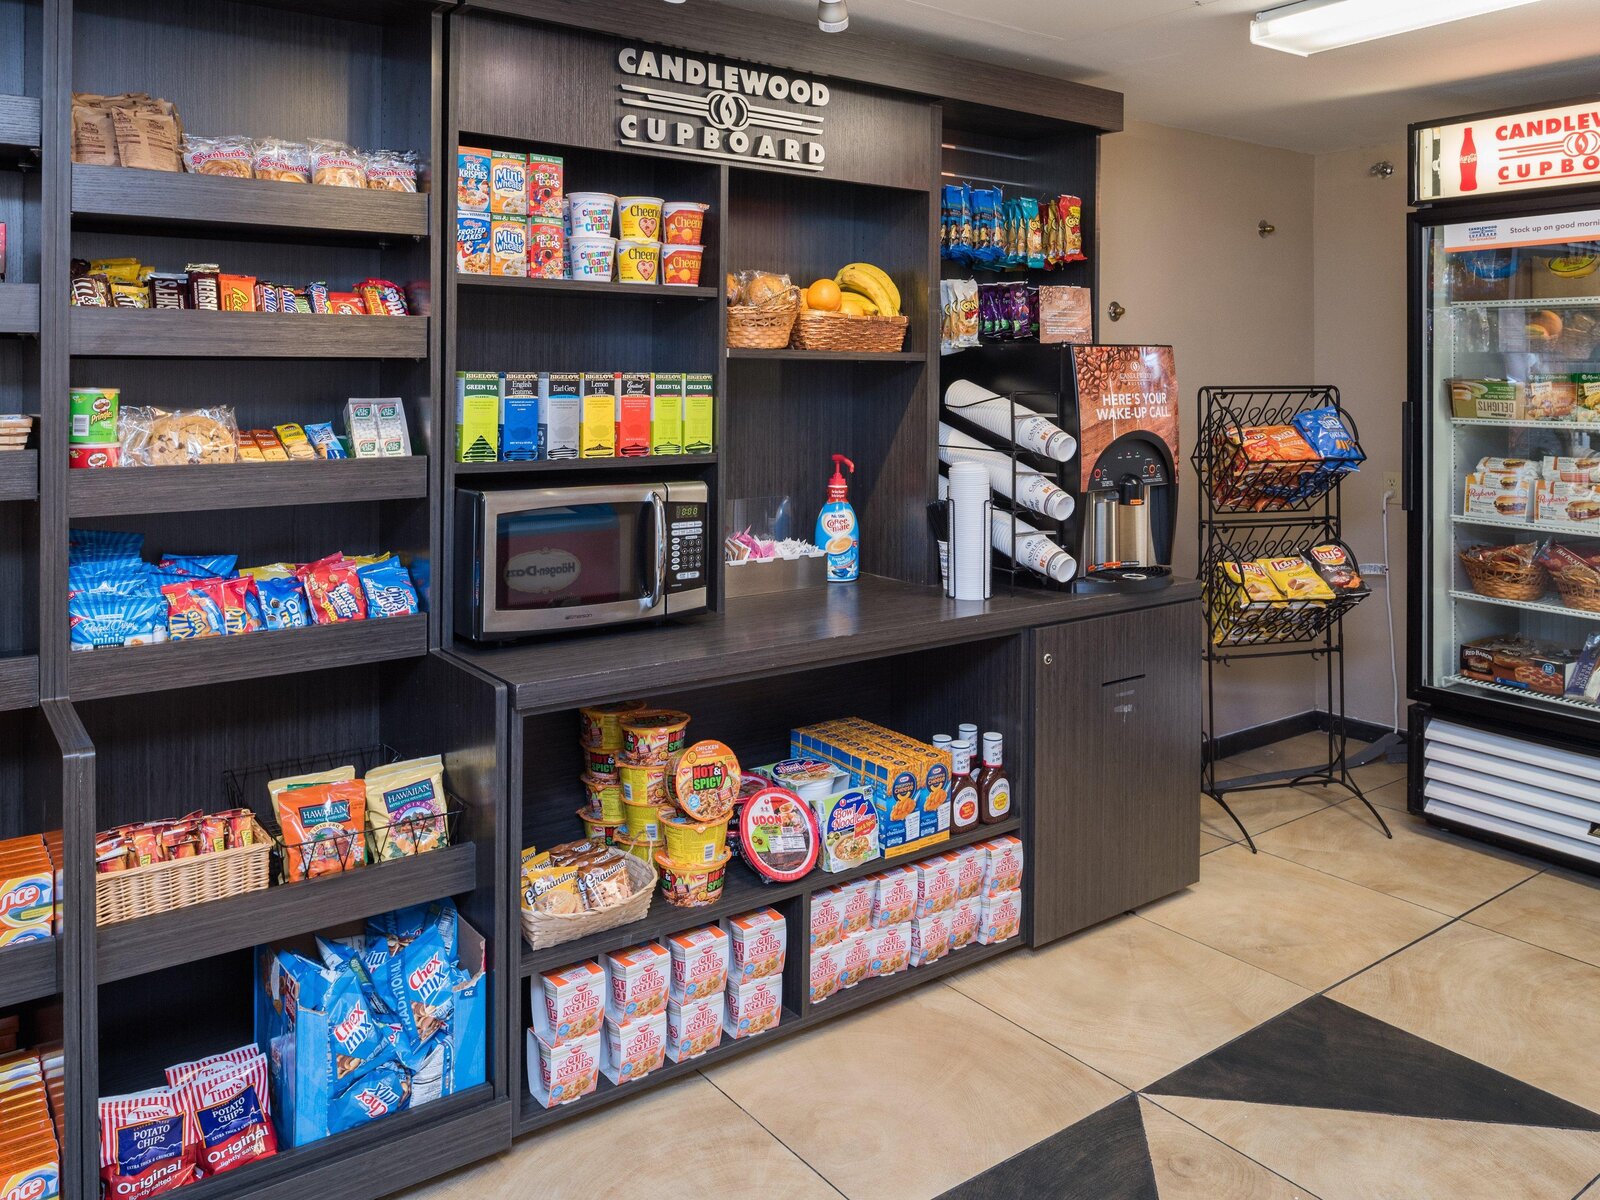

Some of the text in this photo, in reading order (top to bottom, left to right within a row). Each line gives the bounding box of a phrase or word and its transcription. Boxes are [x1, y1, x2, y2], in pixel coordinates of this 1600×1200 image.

[618, 48, 830, 107] CANDLEWOOD
[620, 114, 826, 164] CUPBOARD
[192, 149, 247, 165] Svenhard's
[459, 170, 488, 179] KRISPIES
[466, 163, 481, 172] RICE
[457, 227, 486, 236] FROSTED
[1510, 226, 1530, 234] Stock
[1555, 221, 1575, 233] good
[458, 233, 482, 241] FLAKES
[512, 380, 532, 388] English
[1102, 392, 1167, 406] HERE'S YOUR
[1096, 406, 1147, 421] WAKE-UP
[1477, 401, 1515, 413] DELIGHTS
[91, 411, 113, 425] Pringles
[826, 518, 848, 529] Coffee
[1314, 547, 1342, 562] Lay's
[330, 591, 353, 619] Butter
[334, 584, 359, 614] Nutter
[93, 633, 125, 644] minis
[1476, 650, 1494, 662] BARON
[592, 753, 607, 763] HOT
[591, 763, 615, 773] SPICY
[693, 764, 722, 777] HOT &
[693, 775, 721, 791] SPICY
[387, 783, 432, 804] HAWAIIAN
[396, 801, 430, 819] ORIGINAL
[833, 804, 857, 820] Bowl
[752, 815, 783, 827] UDON
[832, 813, 862, 830] Noodle
[964, 862, 978, 873] CUP
[1001, 855, 1015, 867] CUP
[935, 874, 951, 886] CUP
[891, 886, 908, 897] CUP
[852, 893, 868, 906] CUP
[818, 906, 835, 917] CUP
[957, 909, 971, 922] CUP
[999, 902, 1012, 915] CUP
[930, 922, 944, 935] CUP
[755, 934, 775, 950] CUP
[883, 935, 900, 947] CUP
[748, 939, 781, 959] NOODLES
[852, 945, 867, 958] CUP
[698, 952, 718, 968] CUP
[817, 960, 832, 971] CUP
[409, 952, 441, 992] Chex
[690, 958, 724, 978] NOODLES
[639, 971, 659, 986] CUP
[631, 976, 665, 997] NOODLES
[390, 958, 414, 1032] TRADITIONAL
[571, 989, 592, 1004] CUP
[751, 989, 770, 1004] CUP
[562, 995, 599, 1018] NOODLES
[743, 994, 776, 1014] NOODLES
[333, 1002, 368, 1044] Chex
[693, 1010, 712, 1025] CUP
[685, 1015, 718, 1036] NOODLES
[634, 1030, 654, 1046] CUP
[625, 1036, 661, 1058] NOODLES
[565, 1051, 587, 1067] CUP
[556, 1057, 594, 1080] NOODLES
[207, 1082, 243, 1104] Tim's
[212, 1096, 246, 1119] POTATO
[354, 1090, 389, 1119] Chex
[132, 1108, 170, 1120] Tim's
[218, 1105, 245, 1124] CHIPS
[134, 1124, 170, 1141] POTATO
[211, 1130, 225, 1141] EXTRA
[225, 1128, 237, 1136] THICK
[137, 1134, 166, 1150] CHIPS
[206, 1124, 270, 1164] Original
[140, 1160, 152, 1168] THICK
[116, 1159, 182, 1195] Original
[152, 1175, 172, 1192] salted
